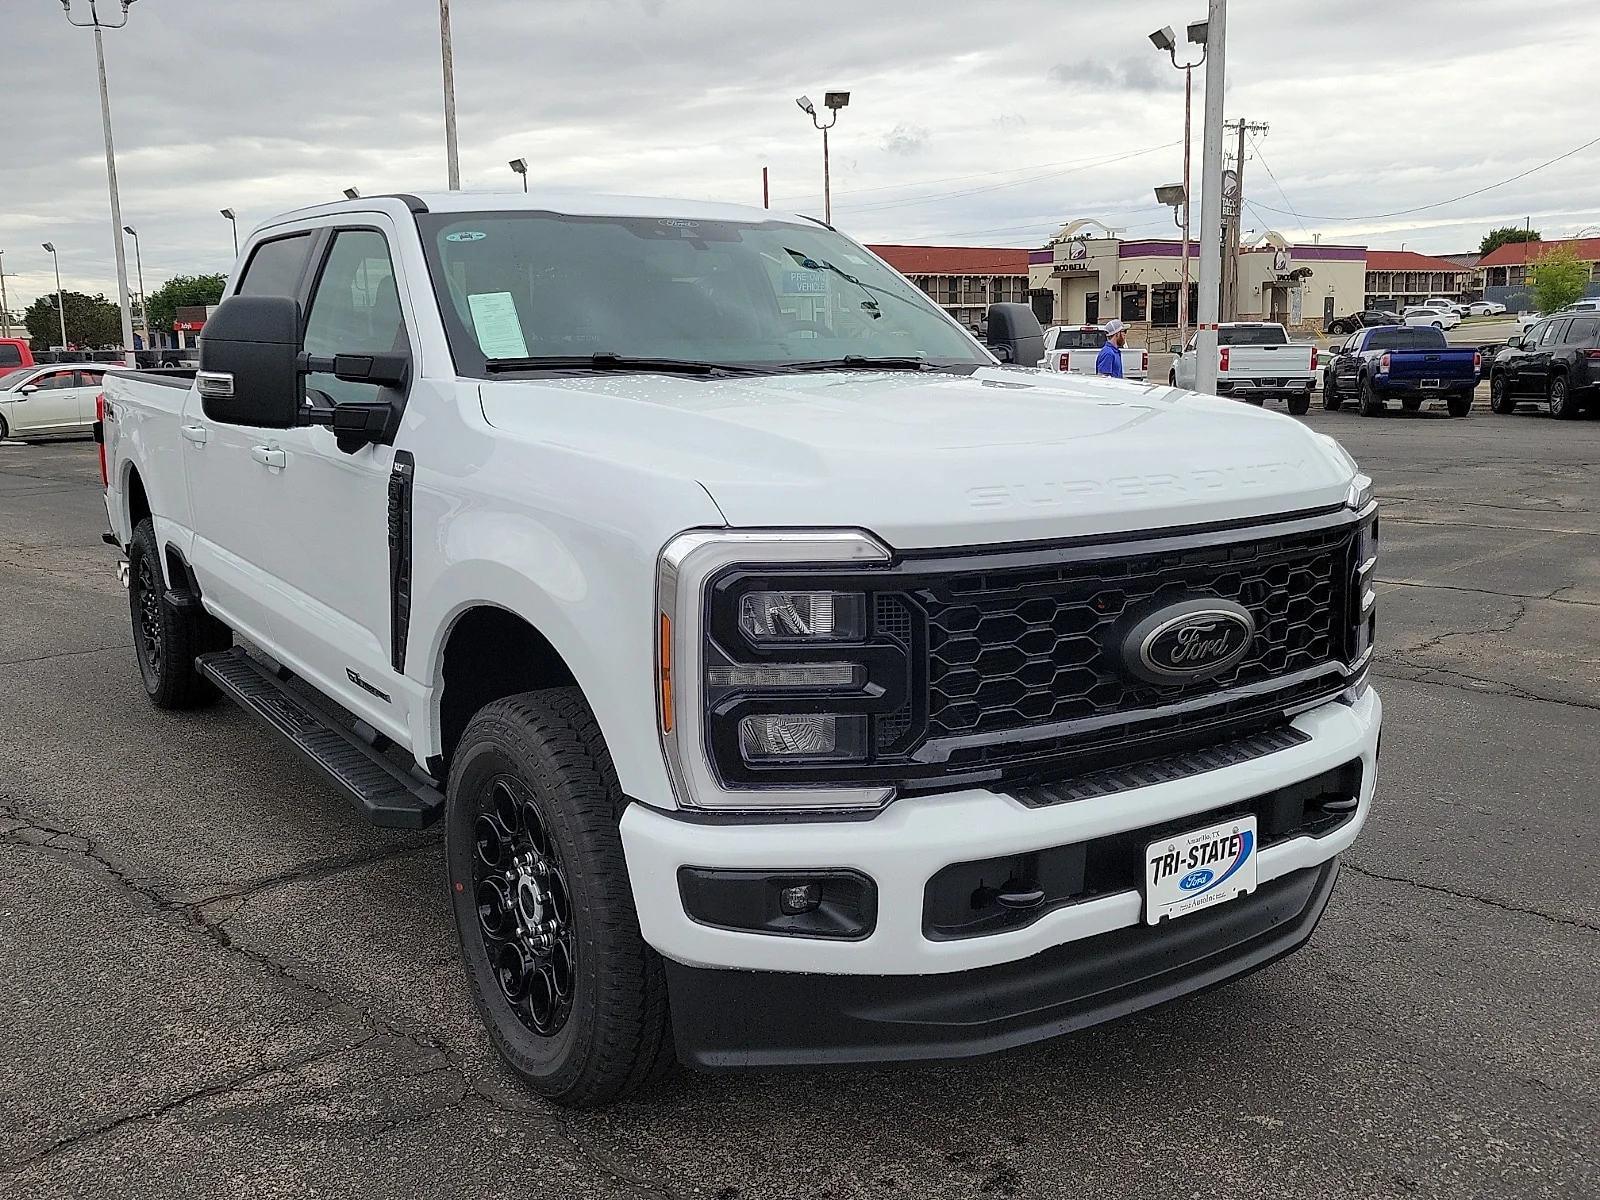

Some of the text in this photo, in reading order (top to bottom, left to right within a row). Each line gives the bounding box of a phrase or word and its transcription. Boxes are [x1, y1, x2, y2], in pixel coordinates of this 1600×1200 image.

[965, 459, 1305, 512] SUPER DUTY
[1170, 623, 1231, 664] Ford
[1211, 830, 1221, 839] TX
[1150, 834, 1239, 887] TRI-STATE
[1185, 872, 1208, 889] Ford
